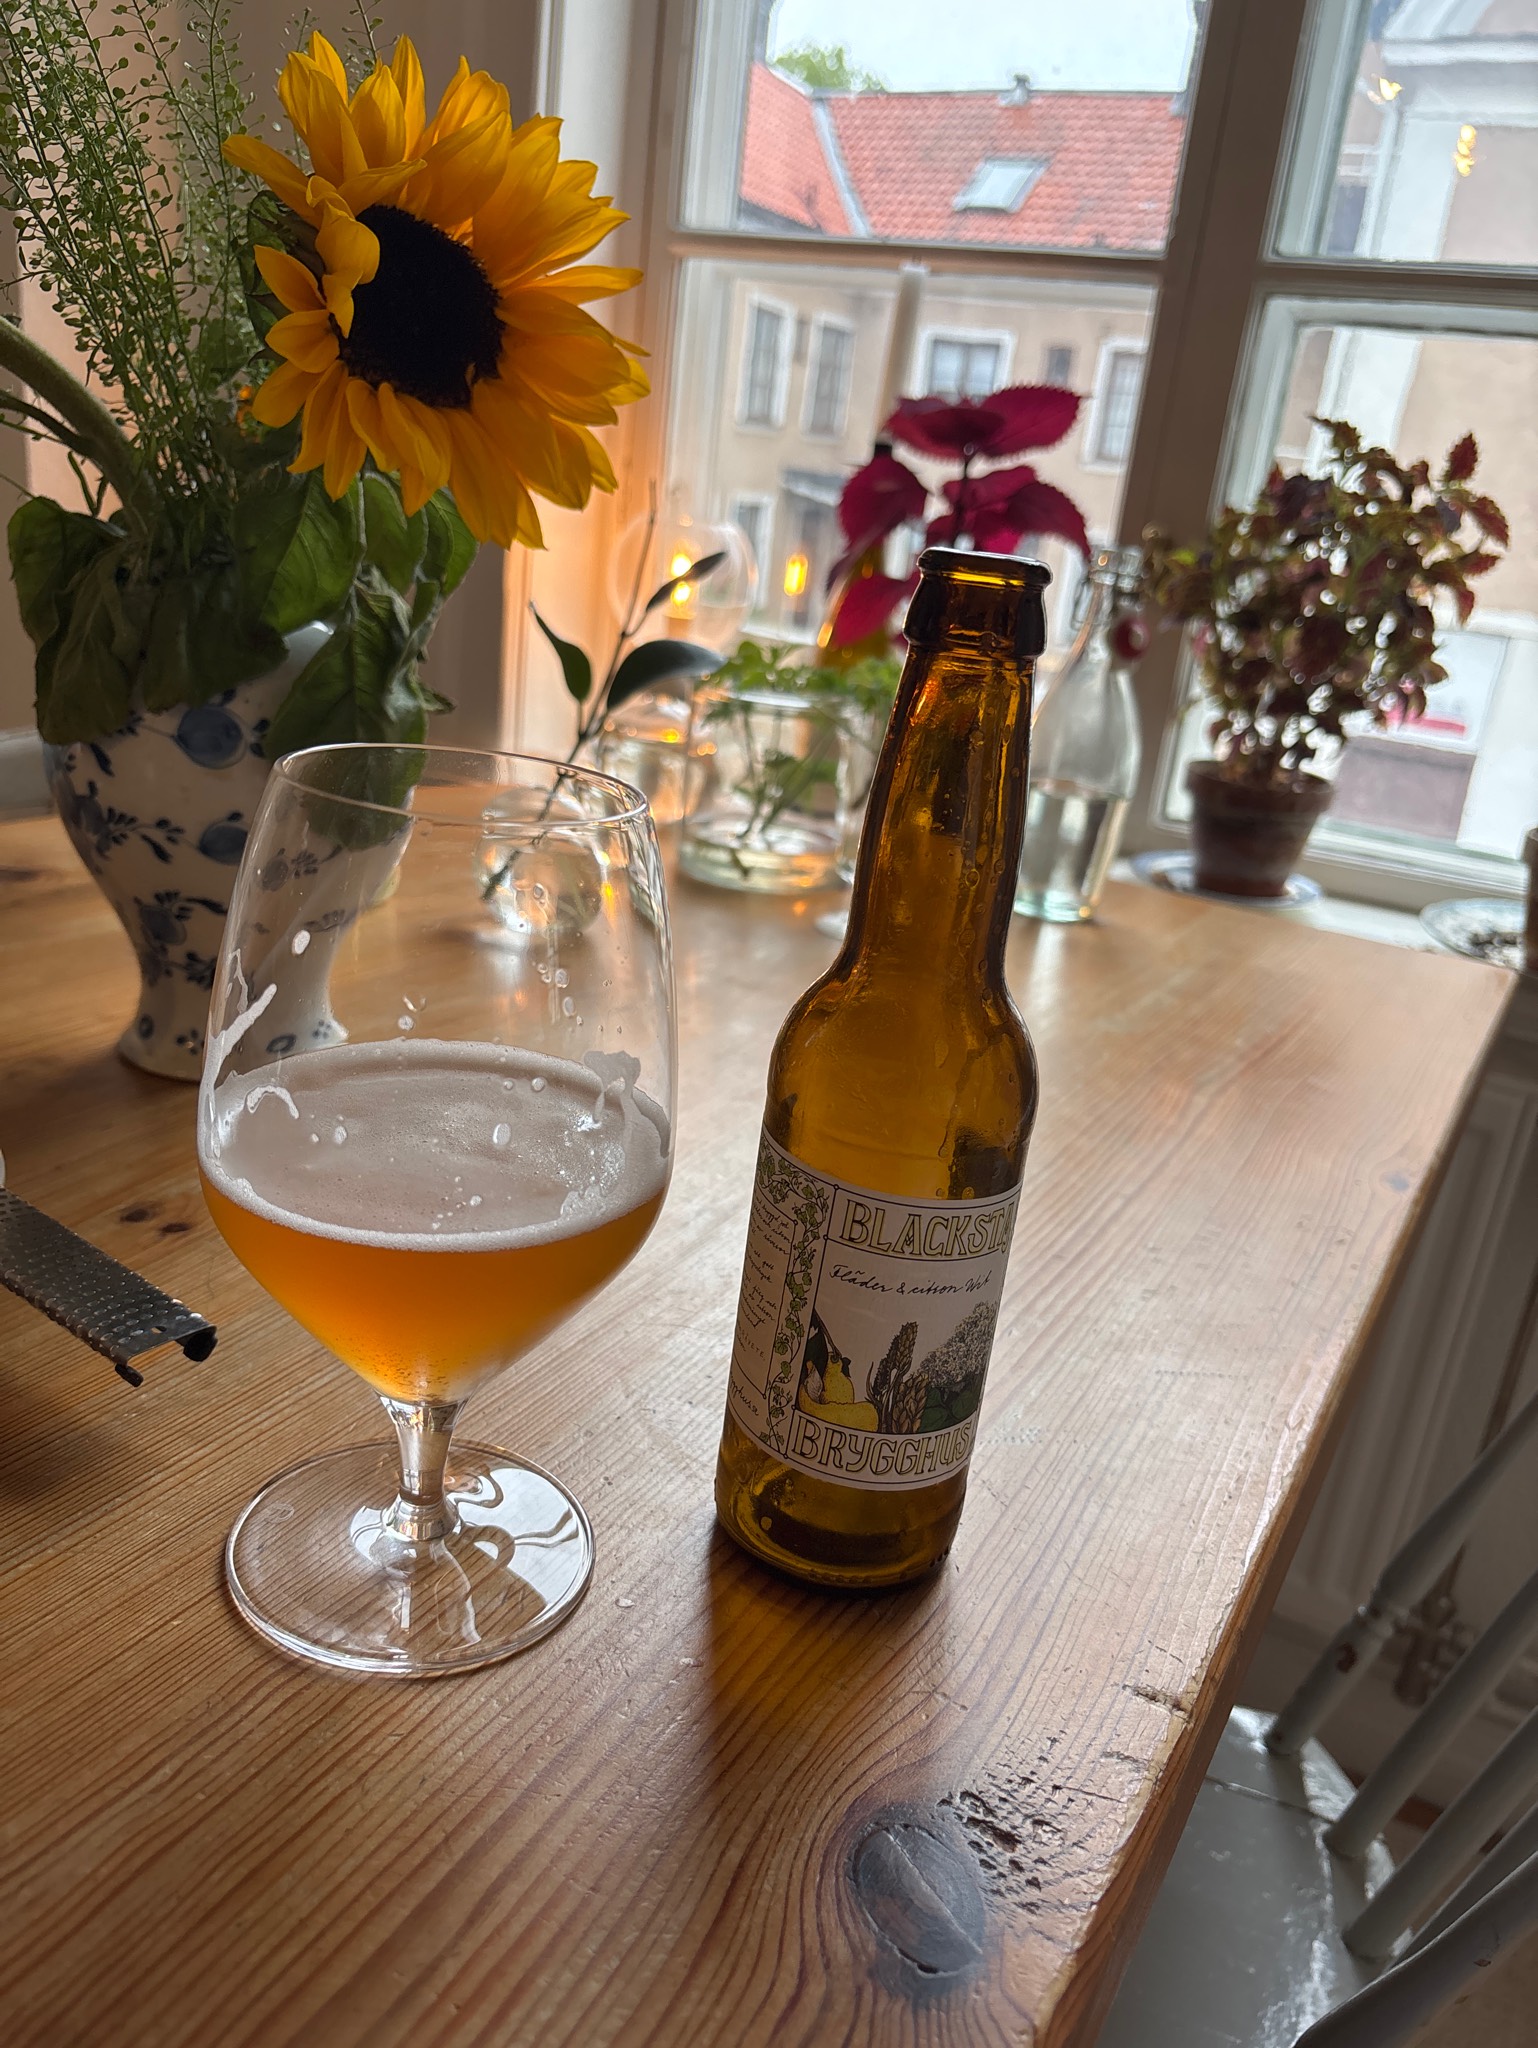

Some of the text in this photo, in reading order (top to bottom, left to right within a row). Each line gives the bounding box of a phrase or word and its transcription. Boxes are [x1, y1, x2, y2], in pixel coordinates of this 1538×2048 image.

[896, 1282, 906, 1295] &
[908, 1280, 963, 1295] citron
[964, 1269, 993, 1293] Wit
[792, 1415, 972, 1476] BRYGGHUS
